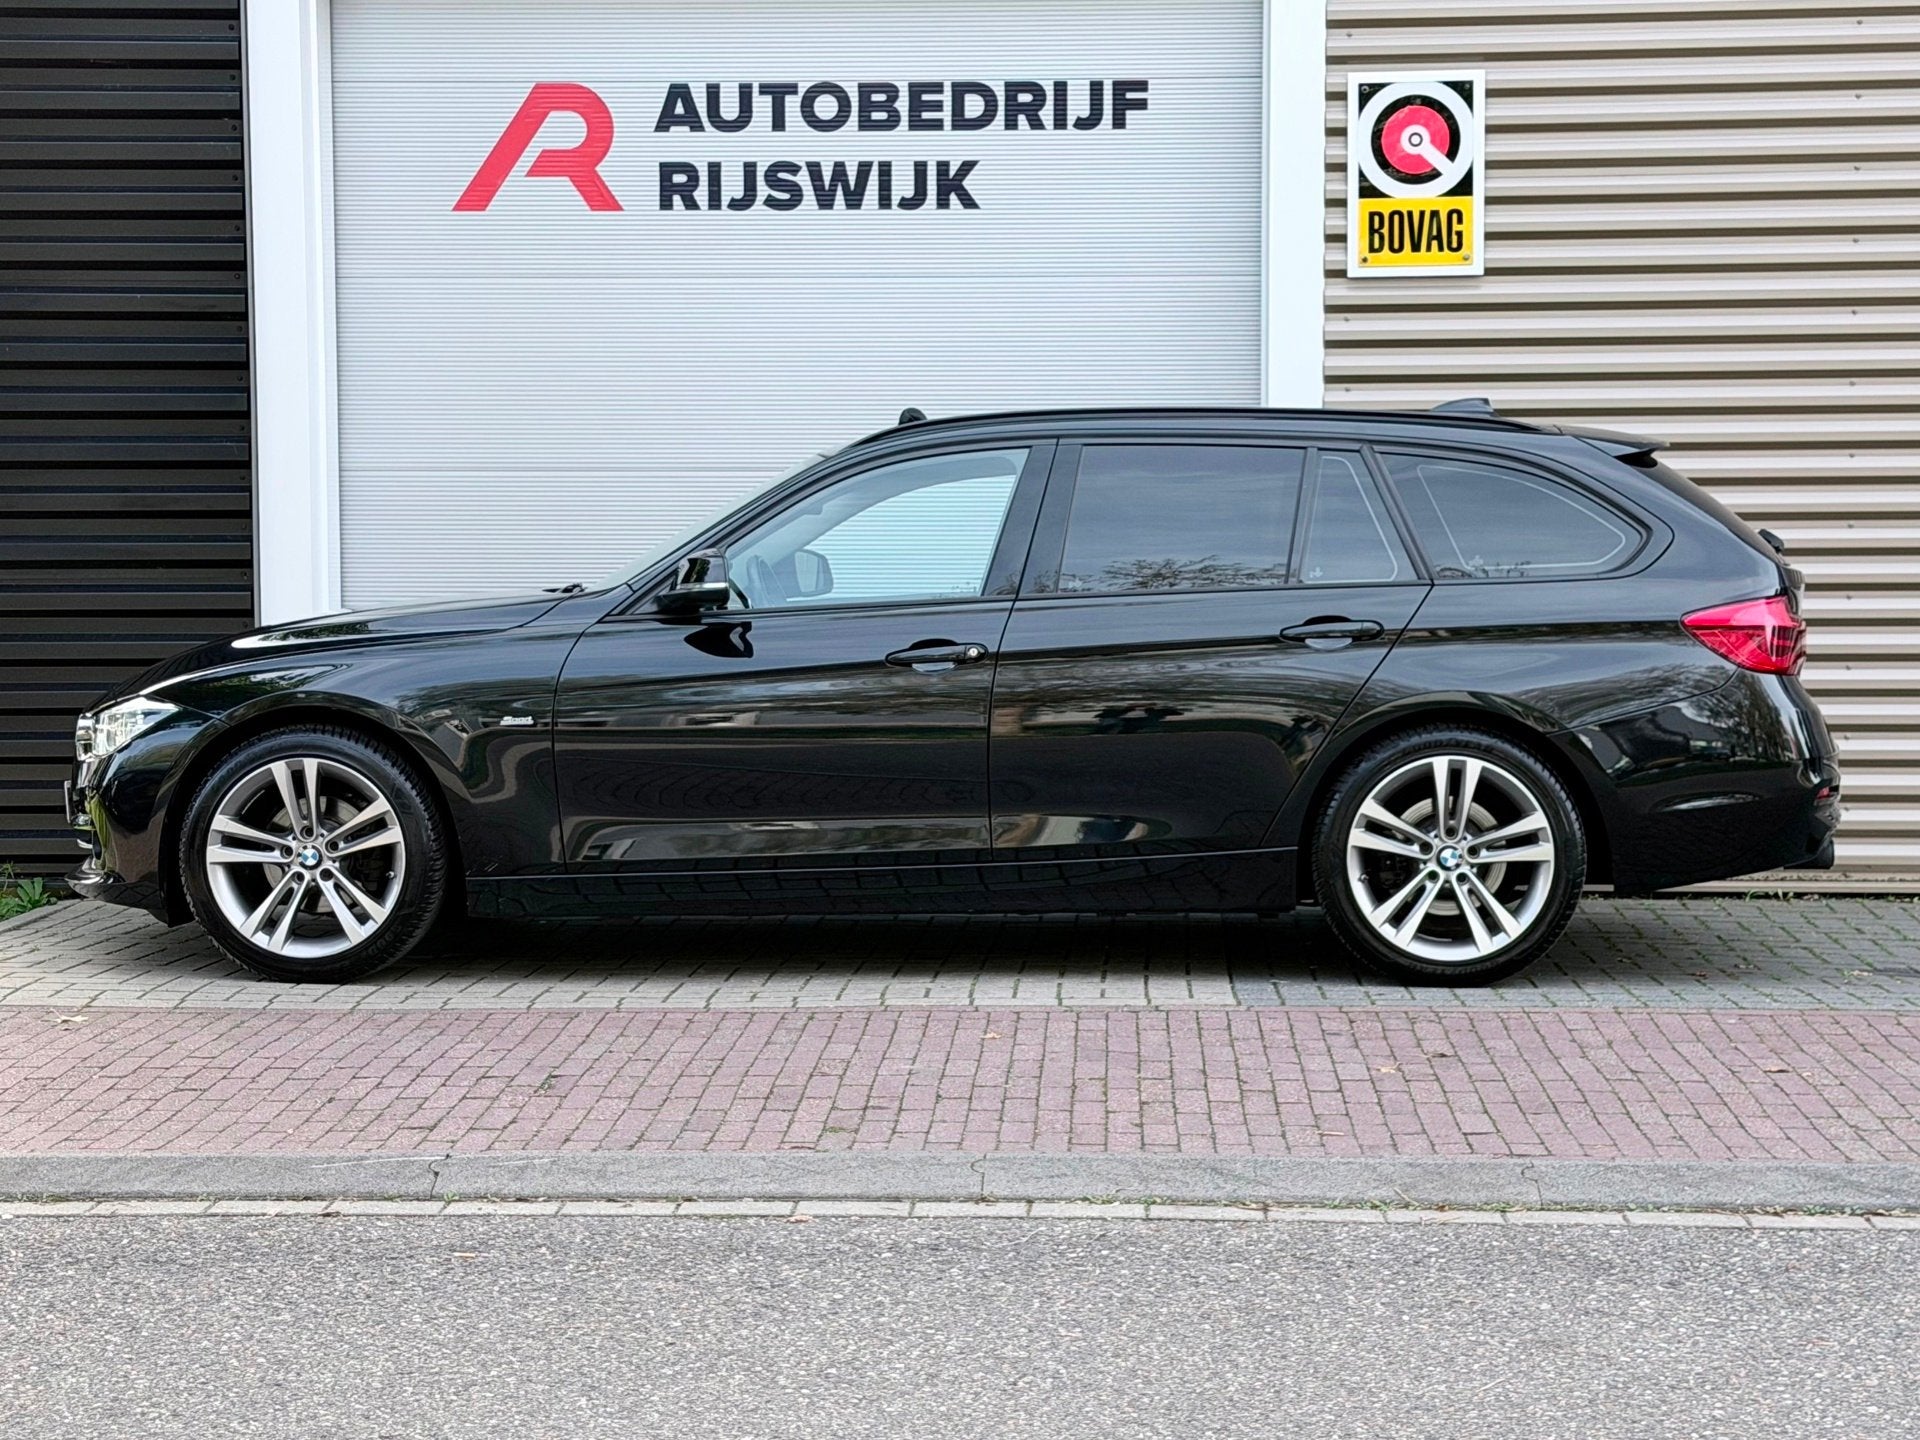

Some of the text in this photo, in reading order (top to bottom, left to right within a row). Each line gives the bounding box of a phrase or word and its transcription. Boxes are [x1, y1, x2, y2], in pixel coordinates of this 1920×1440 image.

[653, 80, 1149, 133] AUTOBEDRIJF
[658, 160, 981, 211] RIJSWIJK
[1368, 208, 1464, 254] BOVAG
